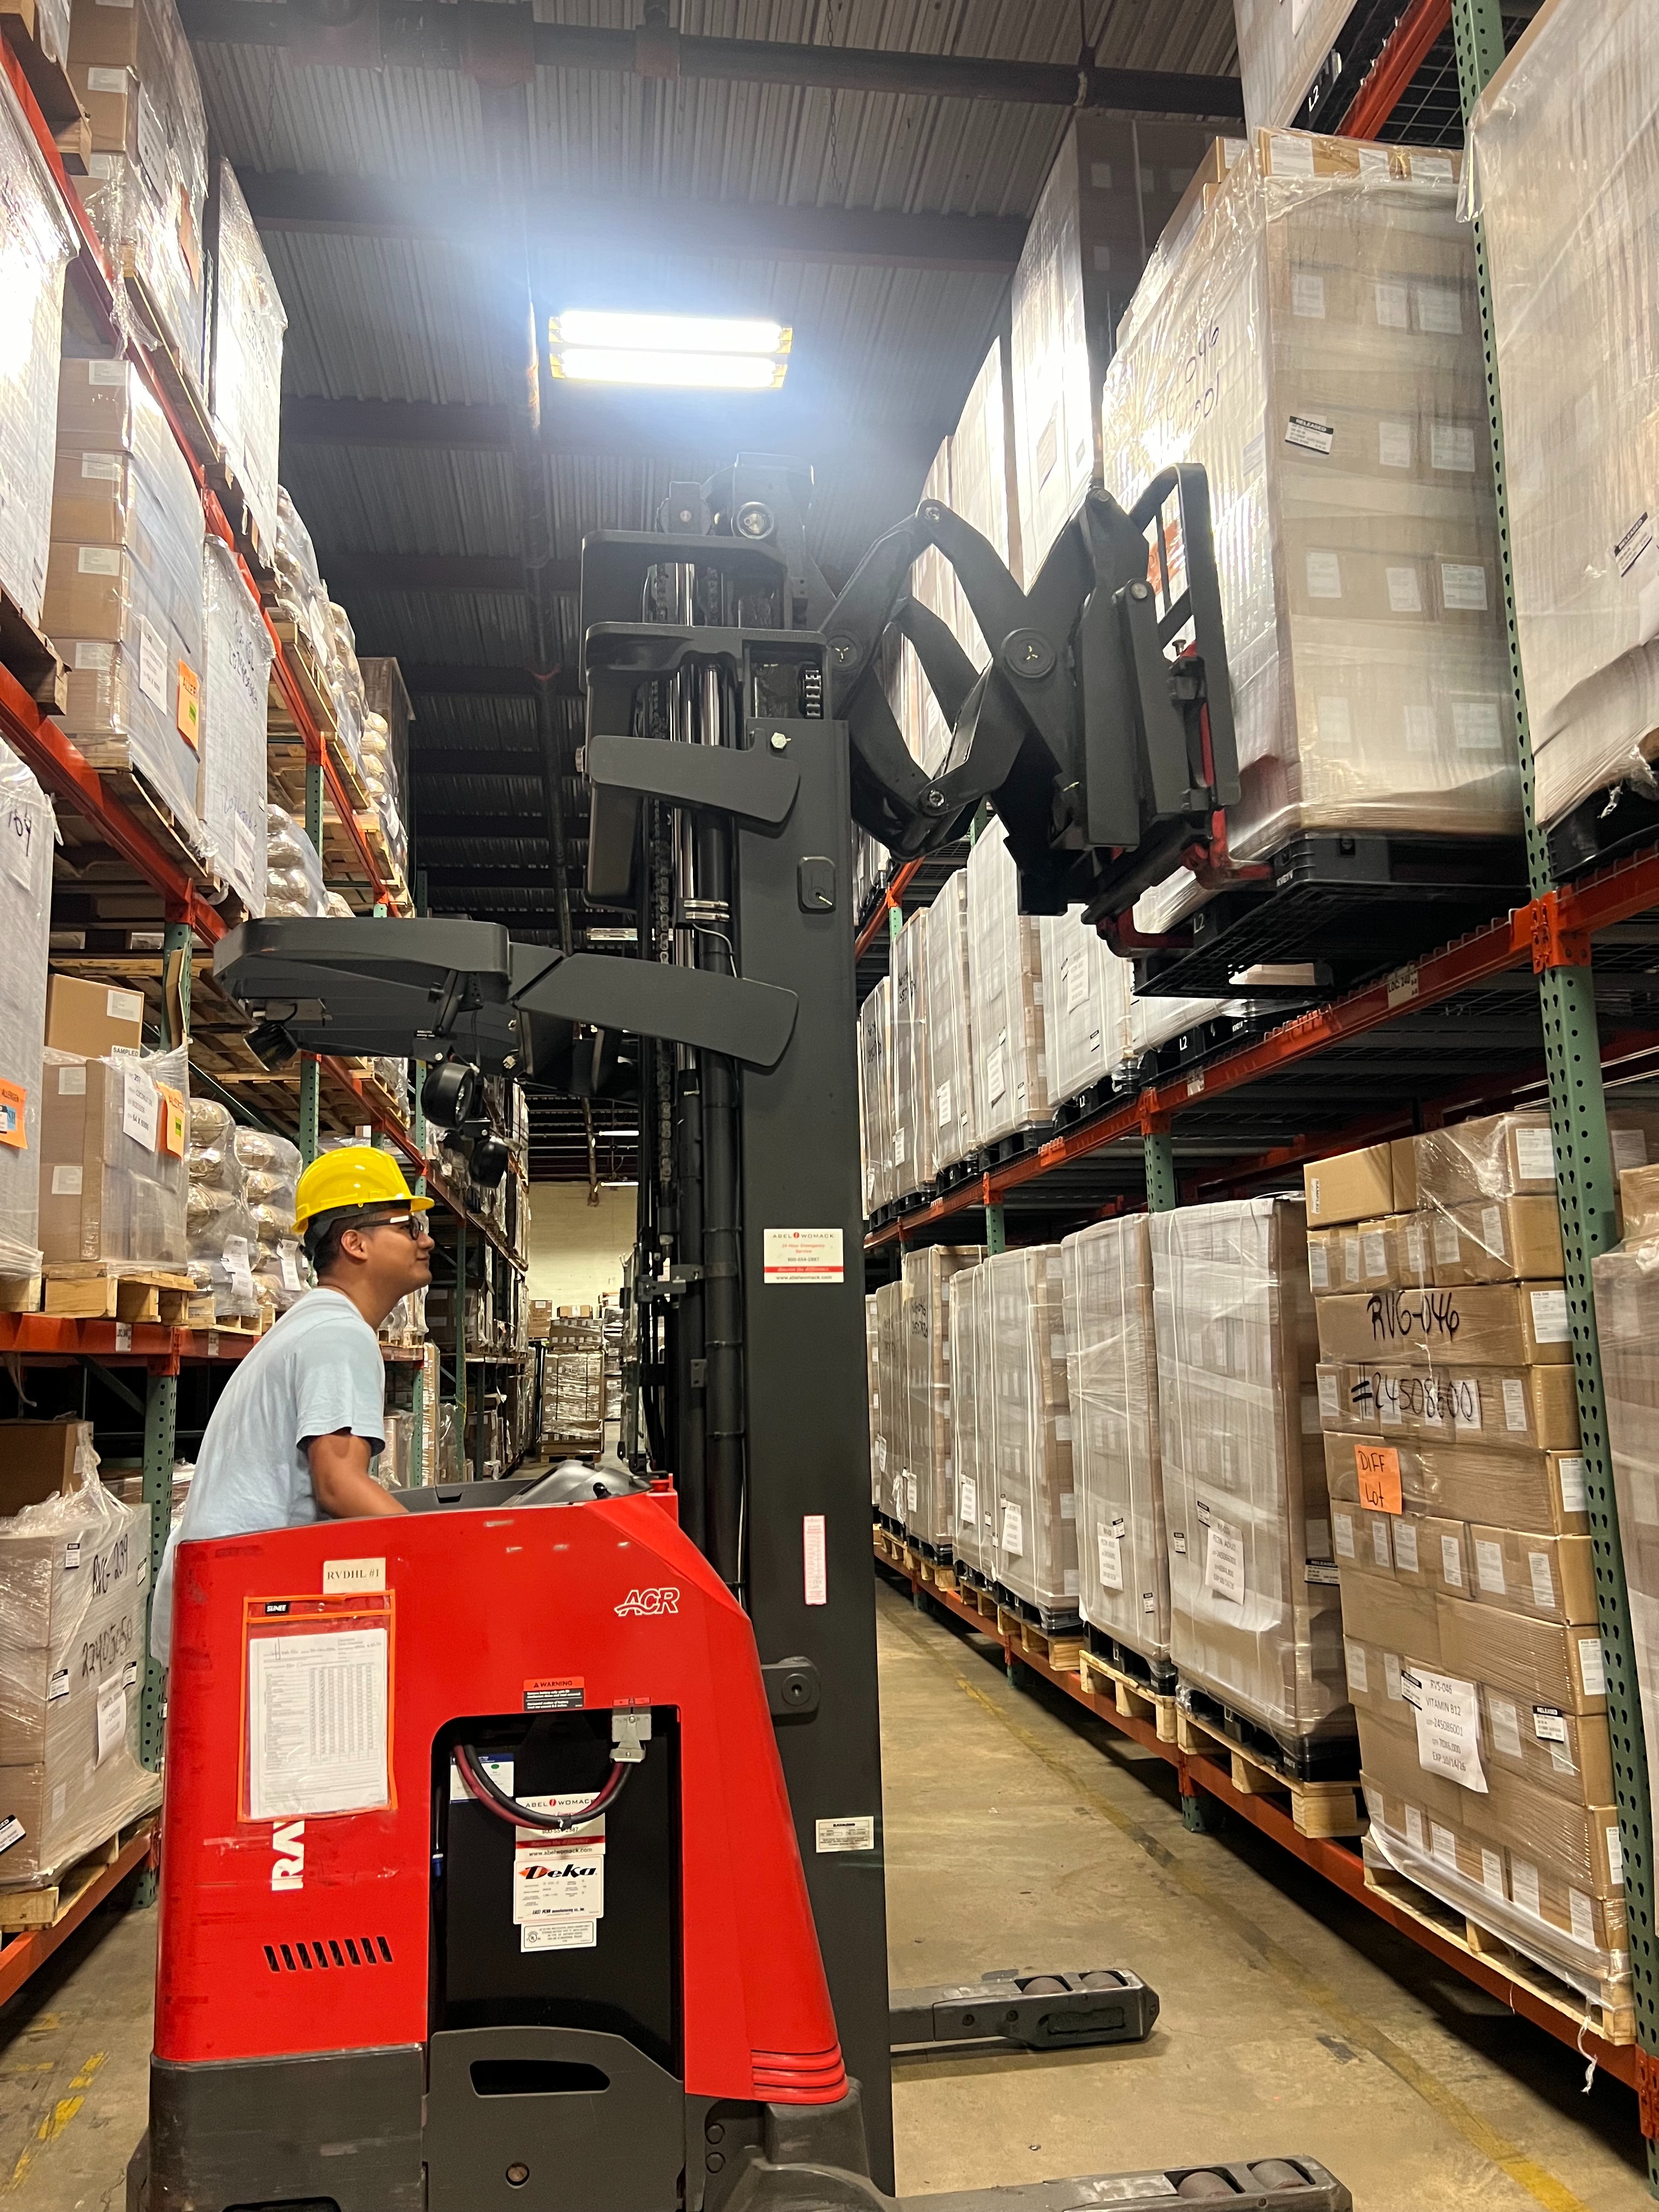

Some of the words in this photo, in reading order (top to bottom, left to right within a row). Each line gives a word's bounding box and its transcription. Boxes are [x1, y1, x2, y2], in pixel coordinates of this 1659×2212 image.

[1296, 419, 1327, 432] RELEASED
[1180, 1035, 1188, 1051] L2
[113, 1047, 139, 1057] SAMPLED
[1367, 1291, 1460, 1343] RVG-046
[1358, 1451, 1385, 1472] DIFF
[327, 1570, 367, 1580] RVDHL
[369, 1568, 380, 1577] #1
[614, 1587, 680, 1617] ACR
[1425, 1696, 1449, 1714] VITAMIN
[1450, 1705, 1462, 1717] B12
[529, 1848, 592, 1857] www.abelwomack.com
[525, 1864, 597, 1880] Deka
